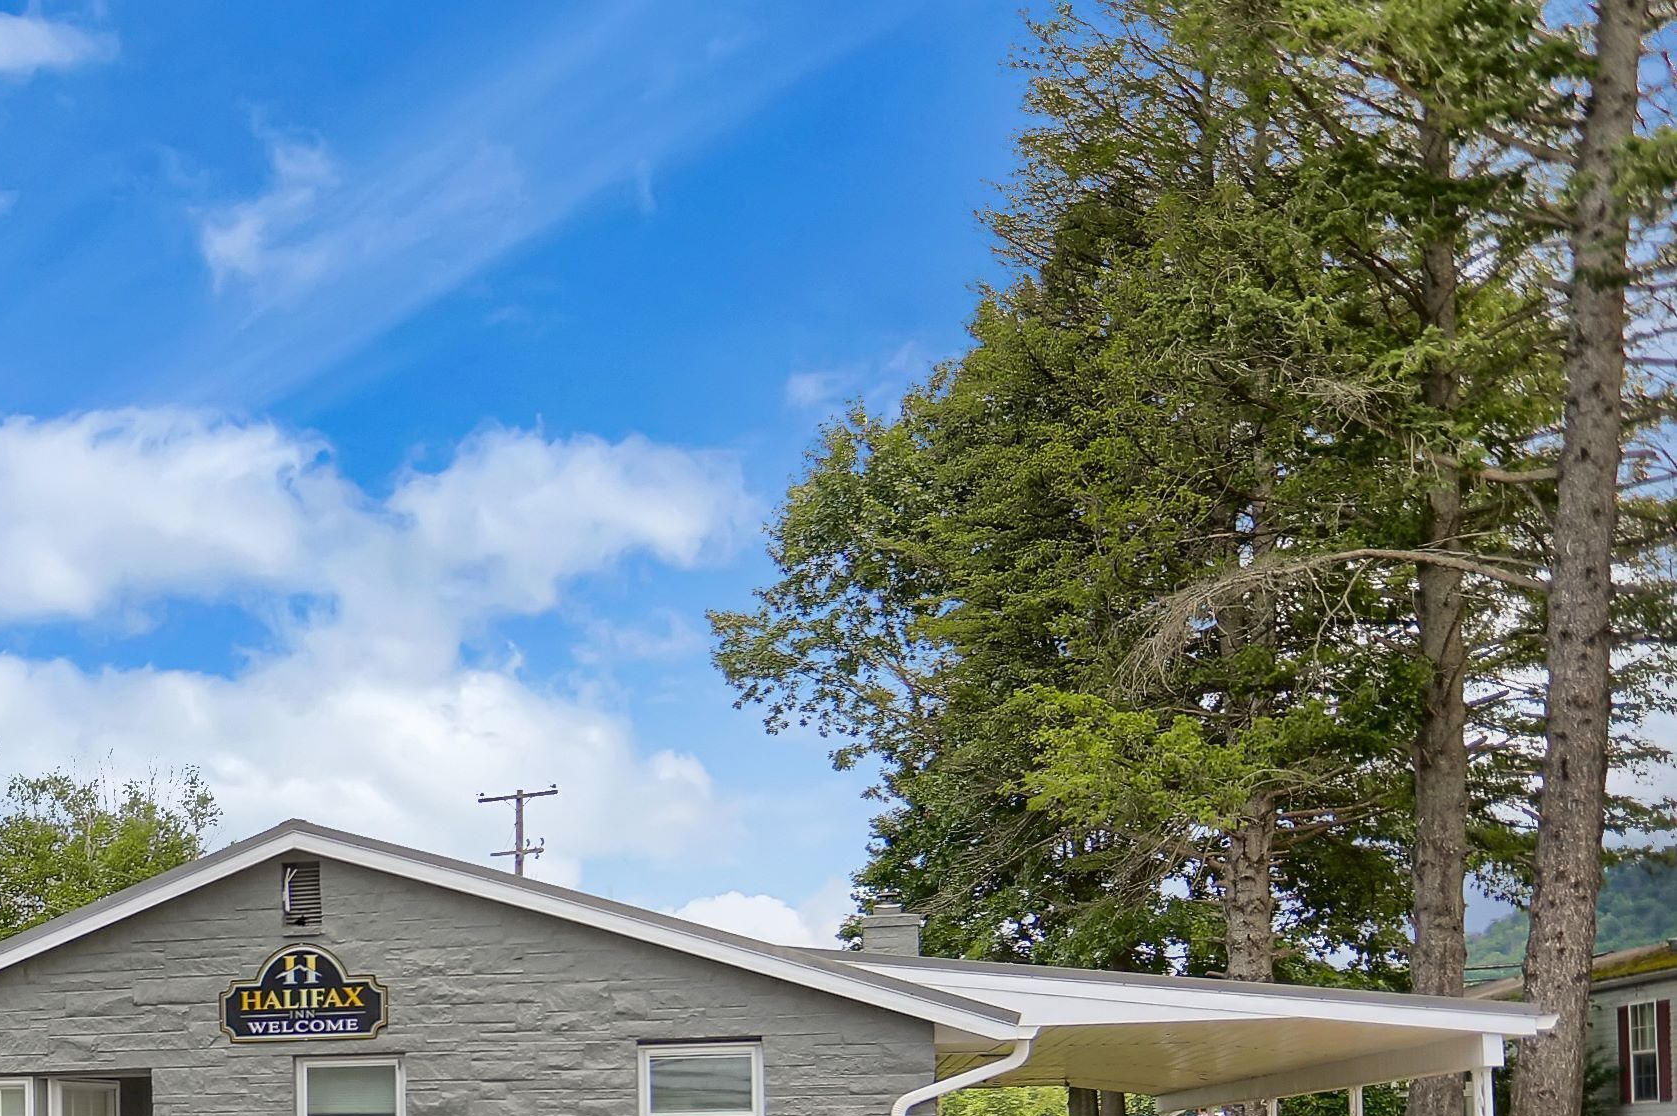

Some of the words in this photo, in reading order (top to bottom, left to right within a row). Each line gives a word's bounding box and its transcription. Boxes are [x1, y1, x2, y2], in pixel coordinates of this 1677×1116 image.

[240, 986, 365, 1011] HALIFAX
[289, 1009, 316, 1019] INN
[247, 1018, 359, 1034] WELCOME
